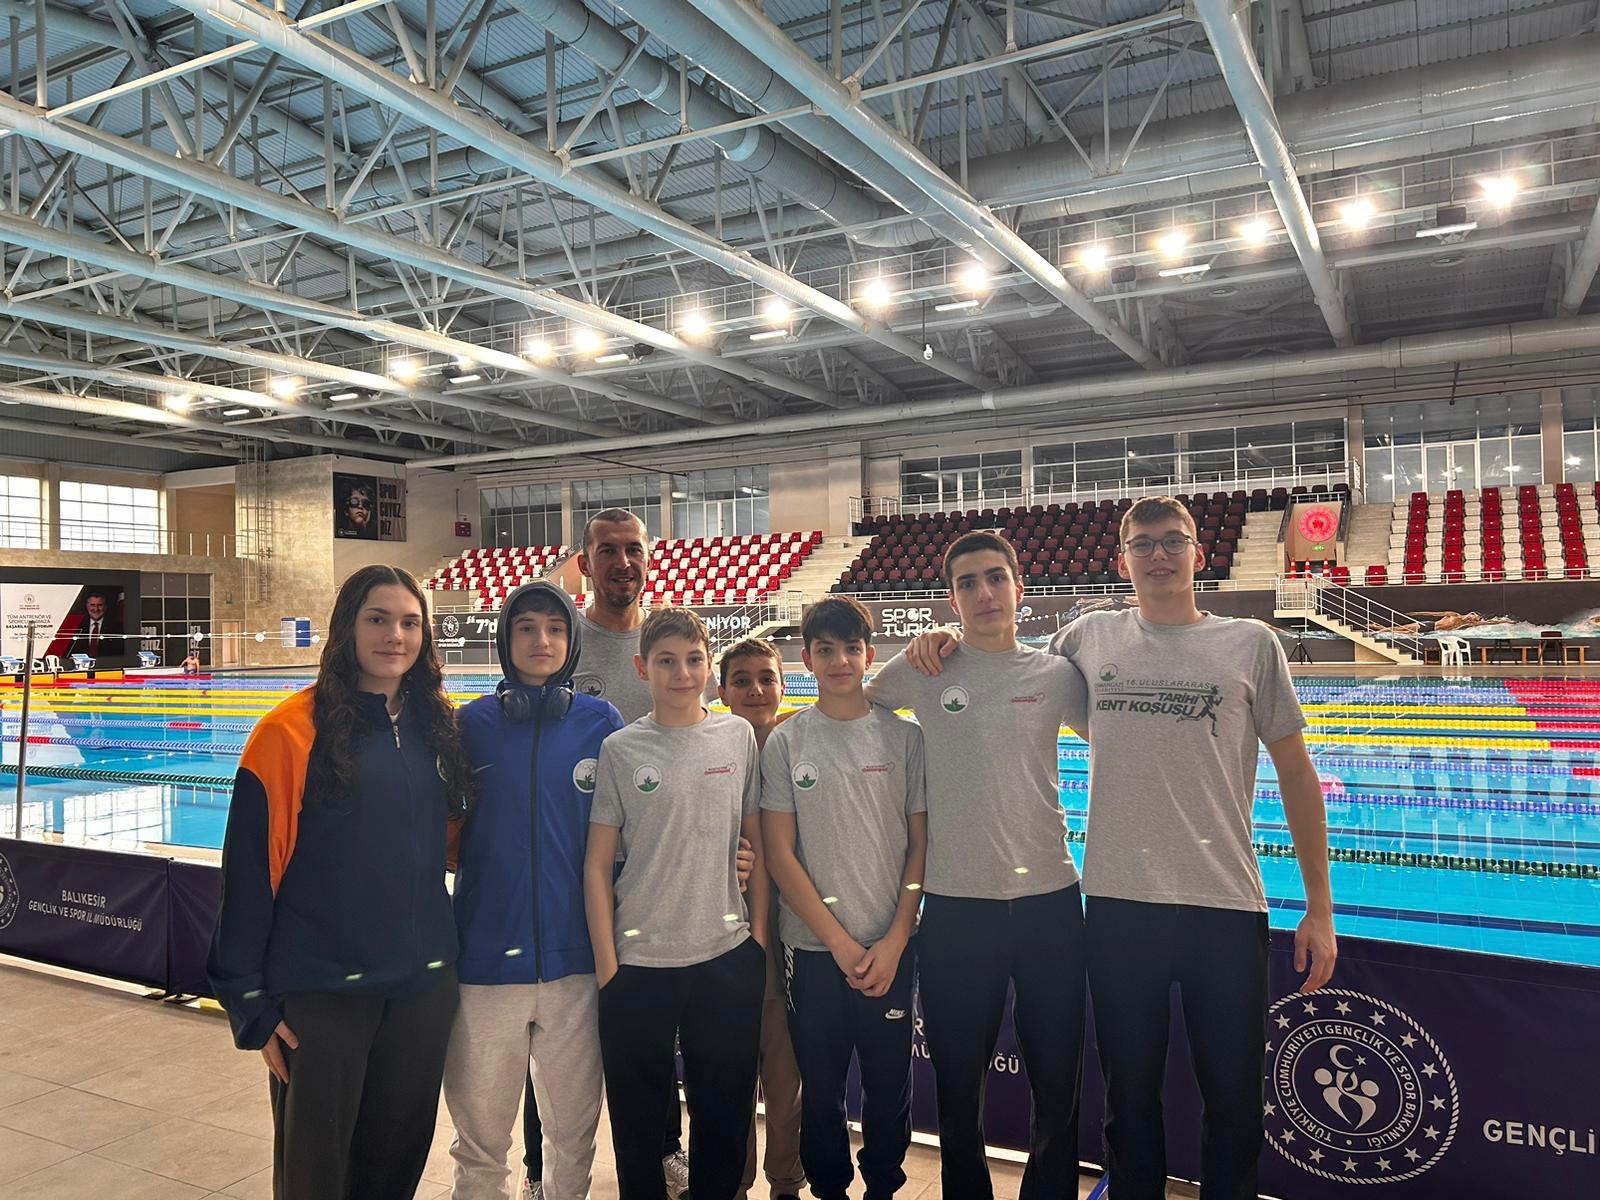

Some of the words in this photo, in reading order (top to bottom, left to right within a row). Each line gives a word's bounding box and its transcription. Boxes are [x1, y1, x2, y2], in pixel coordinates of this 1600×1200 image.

[702, 614, 751, 630] NİYOR
[882, 608, 932, 622] SPOR
[1096, 700, 1126, 711] KENT
[1128, 701, 1195, 716] KOŞUSU
[1158, 692, 1199, 705] TARİHİ
[62, 890, 106, 908] BALIKESİR
[28, 900, 58, 915] GENÇLİK
[59, 906, 68, 917] VE
[69, 908, 86, 921] SPOR
[93, 913, 142, 931] MÜDÜRLÜĞÜ
[1324, 1024, 1385, 1050] GENÇLİK
[1279, 1024, 1323, 1097] CUMHURİYETİ
[1384, 1047, 1401, 1065] VE
[1397, 1065, 1417, 1100] SPOR
[1286, 1099, 1332, 1142] TÜRKİYE
[1366, 1102, 1417, 1148] BAKANLIĞI
[1482, 1119, 1596, 1155] GENÇLİ
